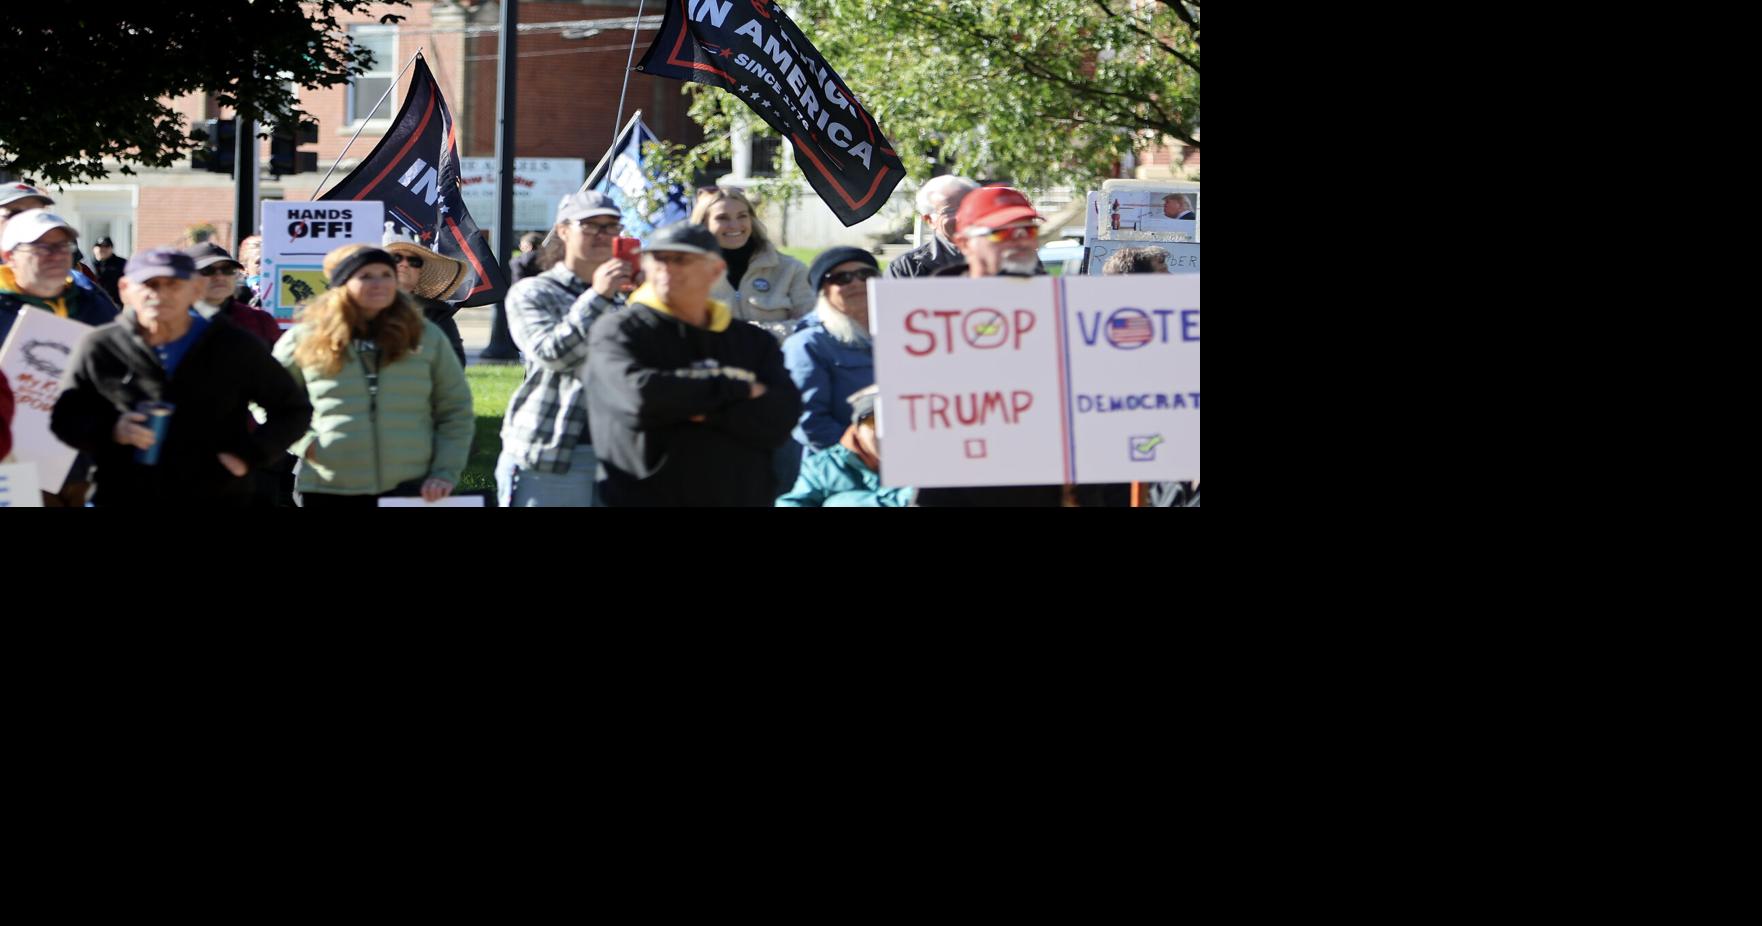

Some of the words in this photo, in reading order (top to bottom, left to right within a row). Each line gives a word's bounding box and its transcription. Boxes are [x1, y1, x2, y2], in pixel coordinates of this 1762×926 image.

[734, 53, 783, 93] SINCE
[734, 18, 873, 170] AMERICA
[288, 209, 352, 220] HANDS
[288, 221, 353, 239] OFF!
[904, 307, 1036, 357] STOP
[1077, 307, 1199, 350] VOTE
[899, 390, 1034, 431] TRUMP
